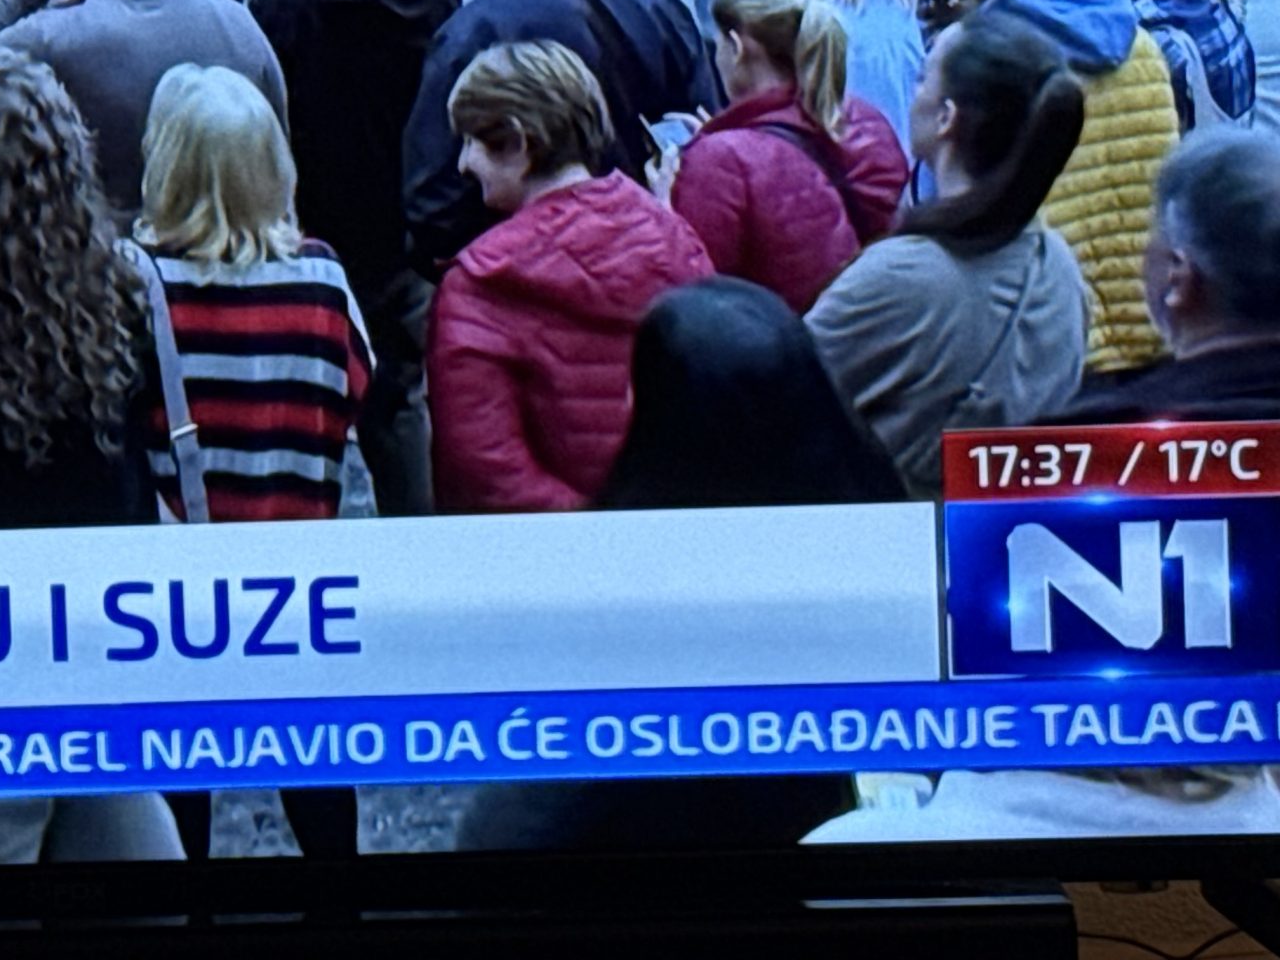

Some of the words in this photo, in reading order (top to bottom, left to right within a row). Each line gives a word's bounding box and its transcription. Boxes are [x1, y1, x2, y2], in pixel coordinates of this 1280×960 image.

[969, 443, 1092, 488] 17:37
[1159, 438, 1260, 482] 17°C
[51, 584, 69, 662] I
[103, 576, 361, 662] SUZE
[1004, 518, 1235, 653] N1
[142, 721, 386, 770] NAJAVIO
[405, 720, 486, 763] DA
[497, 707, 569, 761] ĆE
[585, 705, 1018, 758] OSLOBAĐANJE
[1031, 700, 1264, 748] TALACA
